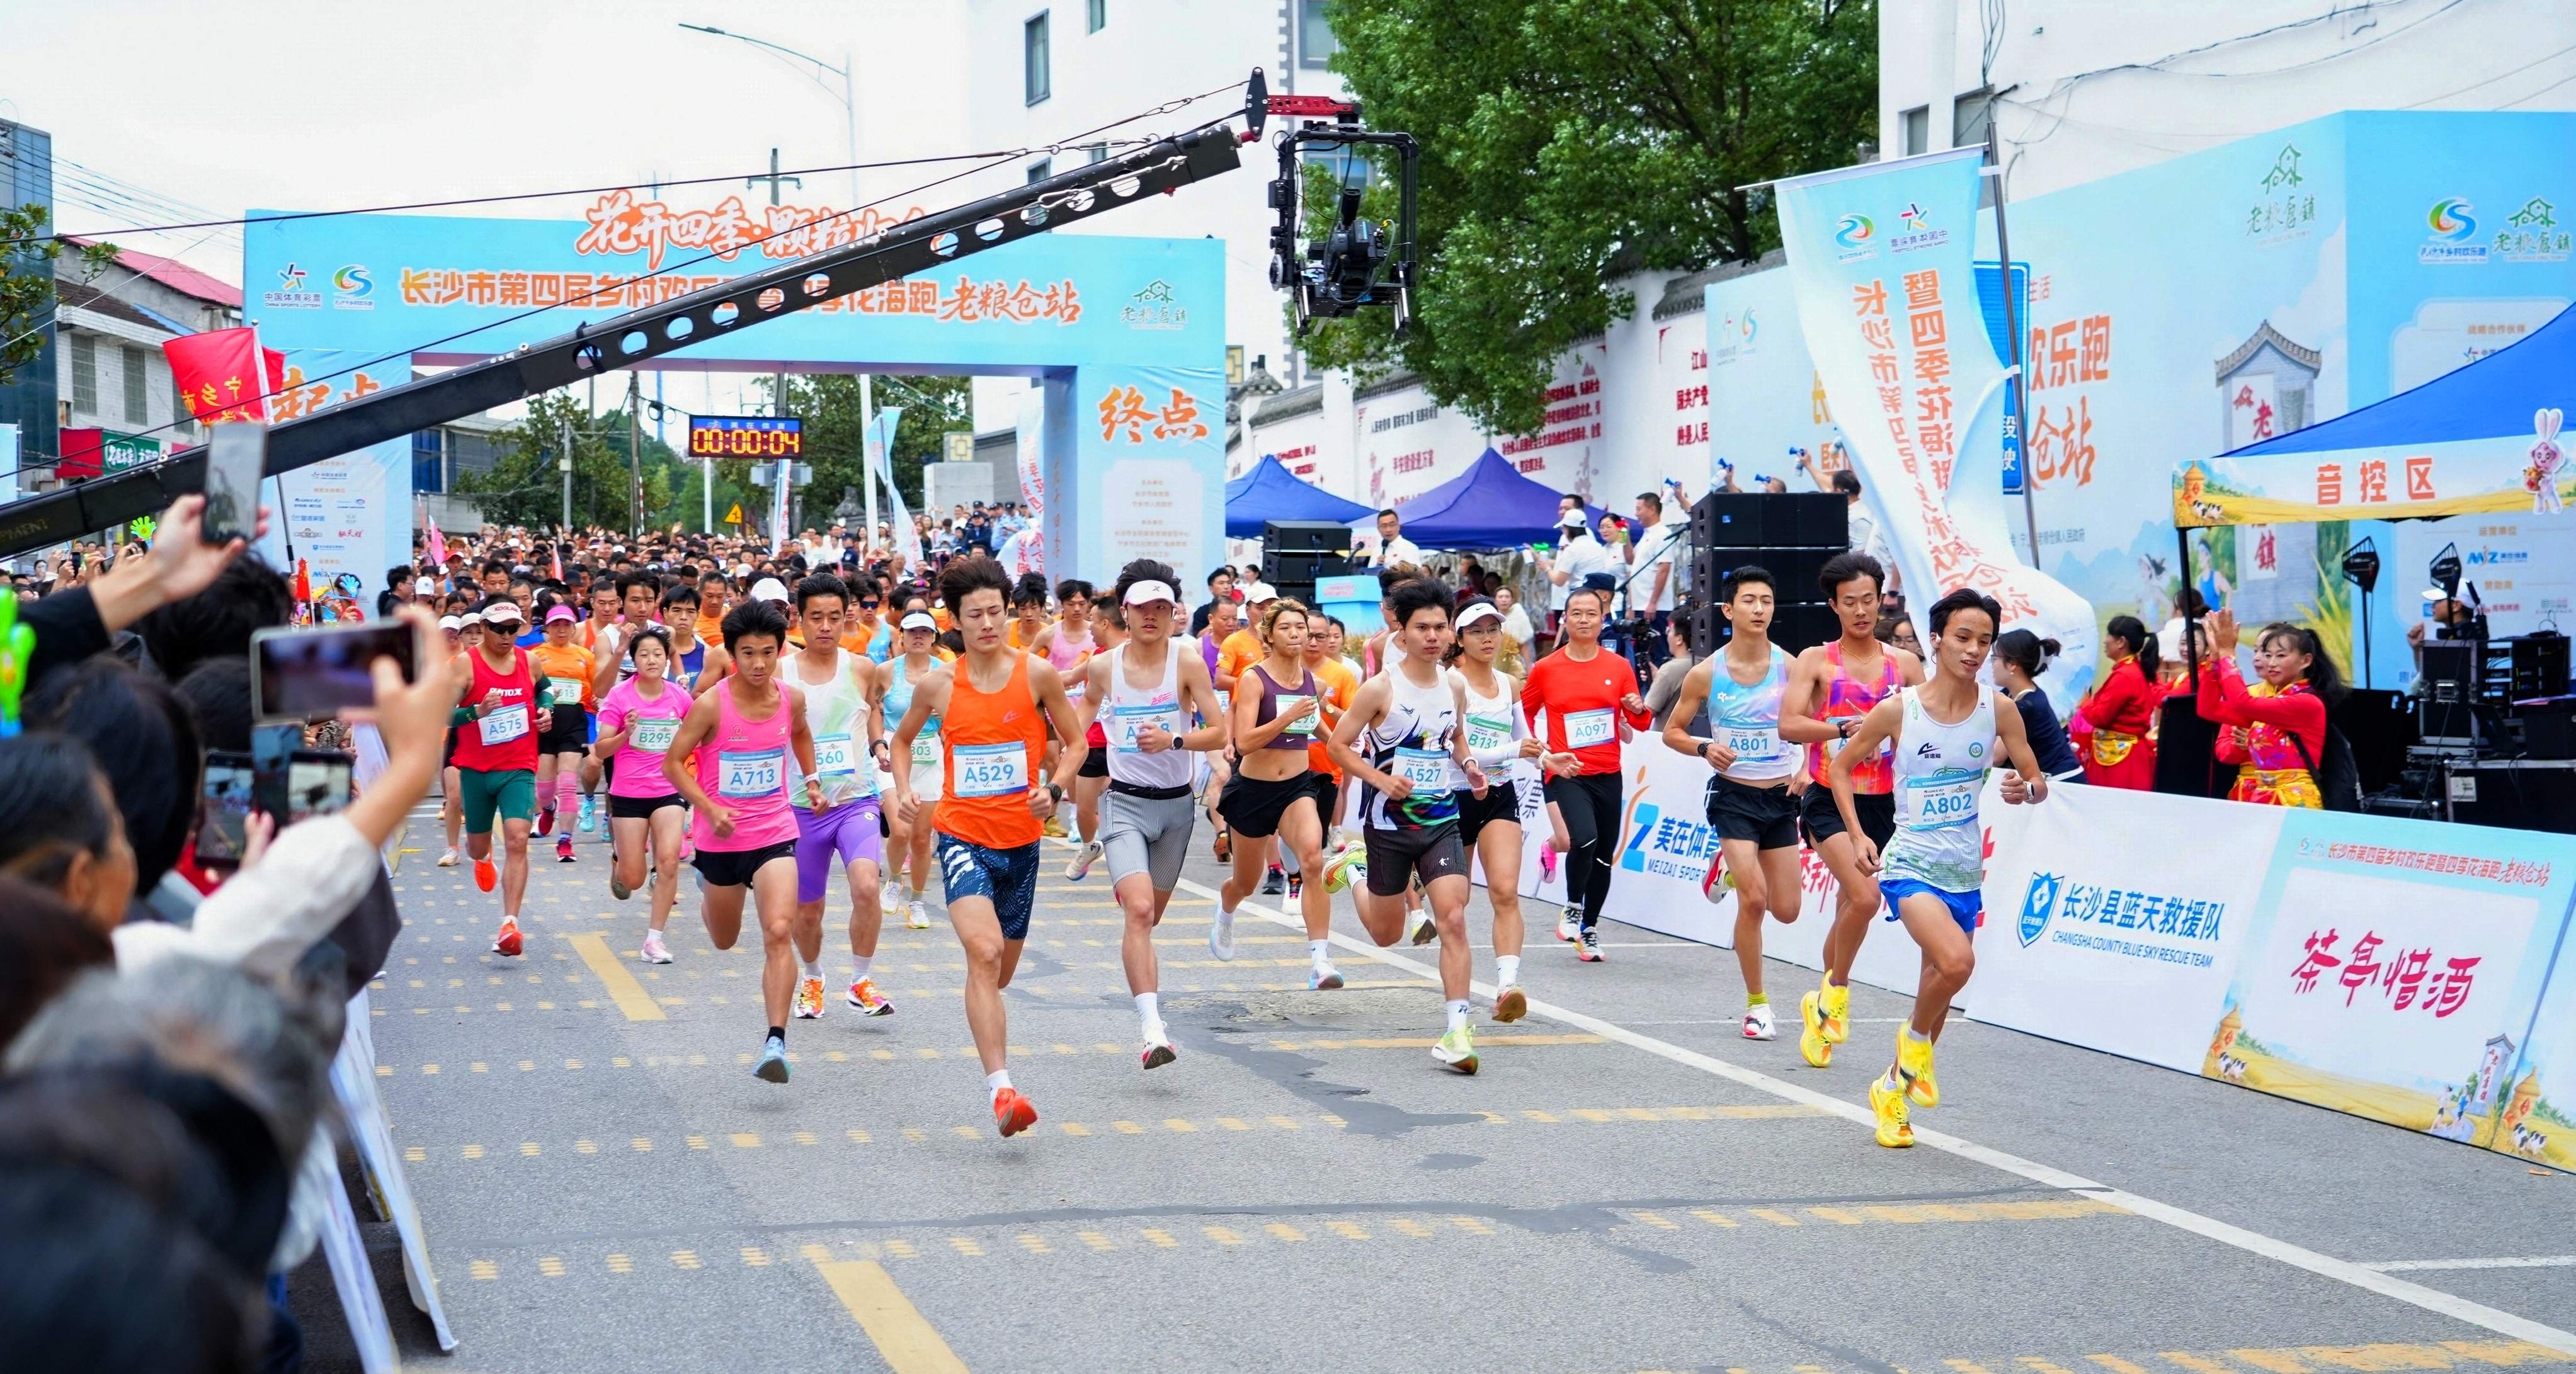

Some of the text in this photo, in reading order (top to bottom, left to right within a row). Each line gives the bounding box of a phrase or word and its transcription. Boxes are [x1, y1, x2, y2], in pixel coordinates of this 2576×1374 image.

[265, 293, 321, 302] 中国体育彩票
[1676, 385, 1708, 411] 国共产党
[1100, 387, 1208, 443] 终点
[693, 428, 800, 455] 00:00:04
[2317, 457, 2436, 505] 音控区
[489, 718, 522, 735] A575
[1575, 723, 1607, 738] A097
[639, 732, 671, 743] B295
[1729, 737, 1769, 751] A801
[816, 750, 844, 766] 560
[730, 768, 775, 786] A713
[964, 764, 1015, 783] A529
[1403, 767, 1442, 783] A527
[1922, 793, 1972, 816] A802
[1653, 816, 1722, 861] 美在体育
[1647, 858, 1678, 878] MEIZAI
[2061, 882, 2225, 941] 长沙县蓝天救援队
[2052, 930, 2214, 968] CHANGSHA COUNTY BLUE SKY RESCUE TEAM
